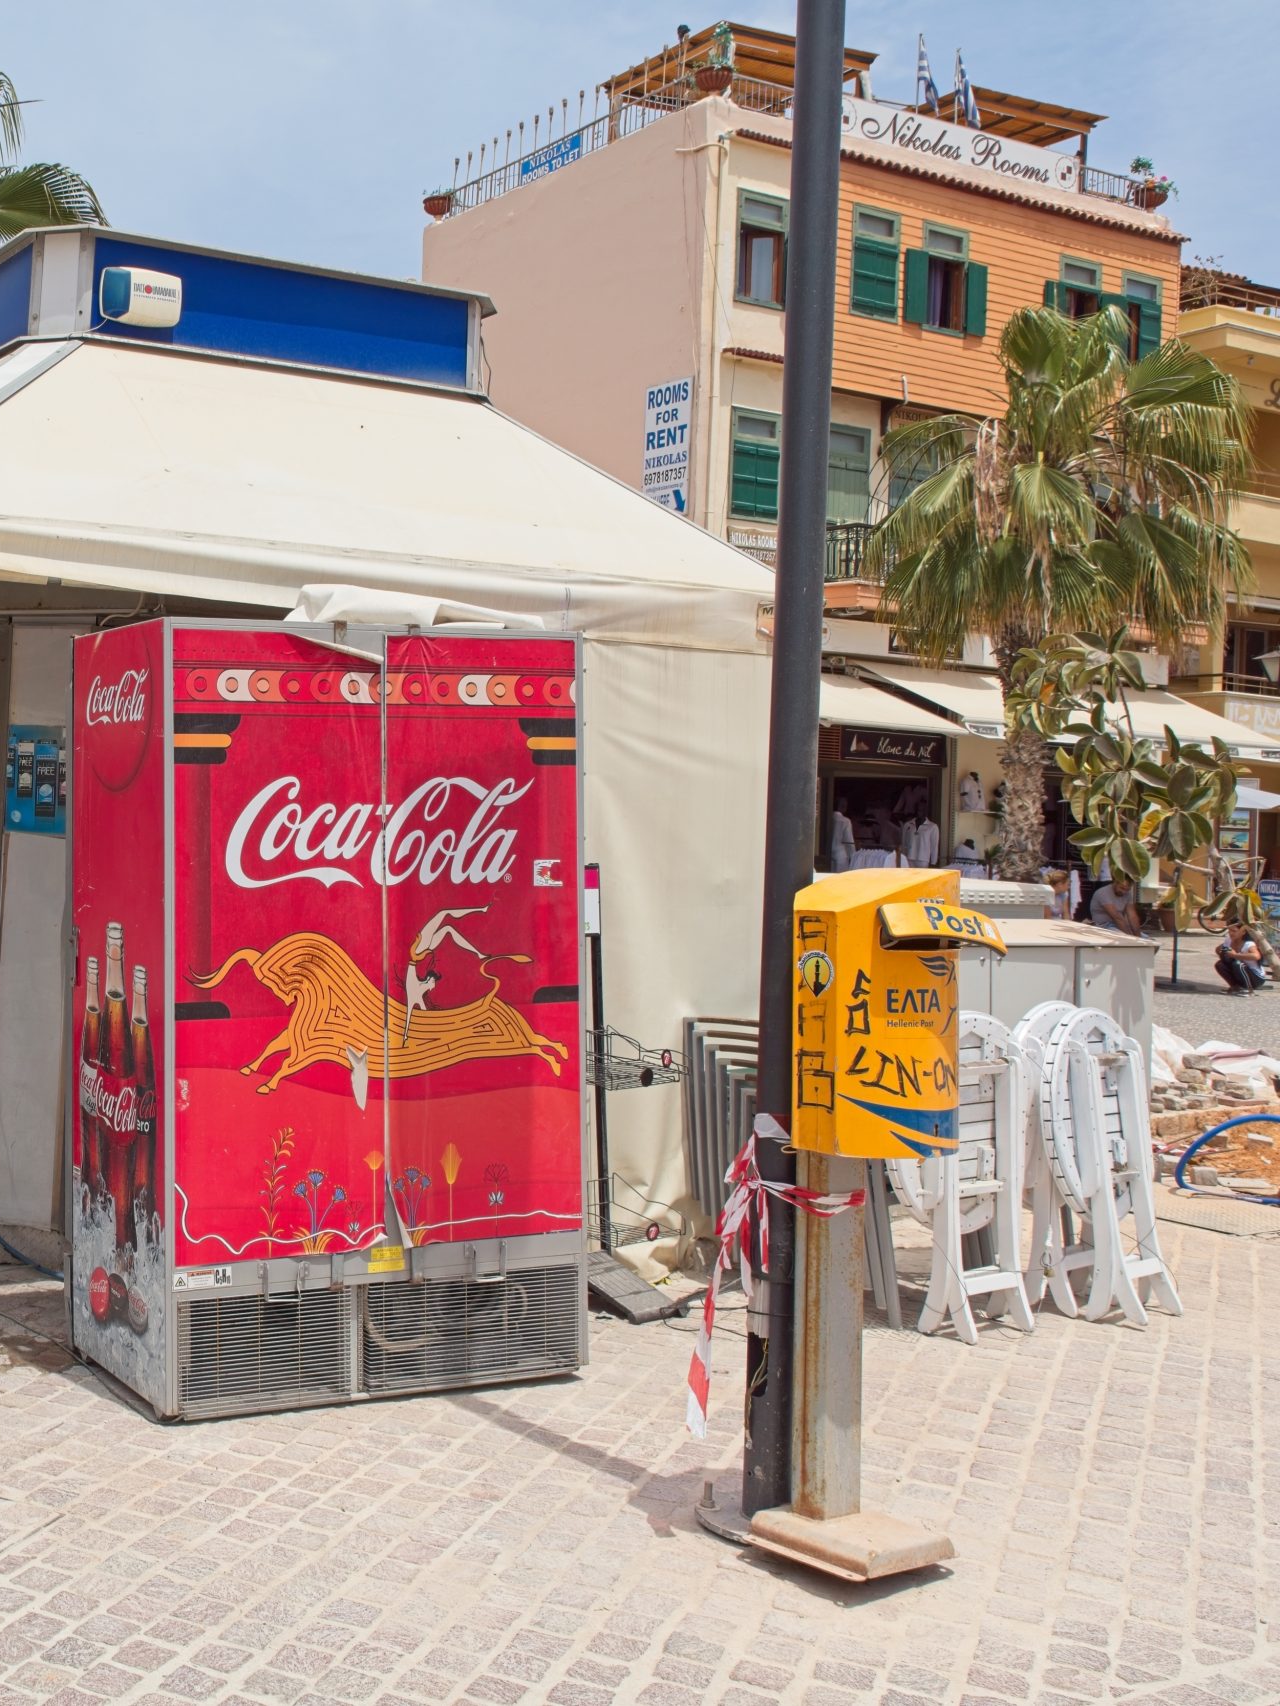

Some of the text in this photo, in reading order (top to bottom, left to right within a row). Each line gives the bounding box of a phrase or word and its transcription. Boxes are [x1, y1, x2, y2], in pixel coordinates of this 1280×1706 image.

[529, 140, 571, 170] NIKOLAS
[860, 112, 1050, 184] Nikolas Rooms
[522, 148, 580, 185] ROOMS TO LET
[647, 381, 689, 410] ROOMS
[655, 408, 679, 426] FOR
[646, 424, 688, 451] RENT
[644, 451, 688, 470] NIKOLAS
[644, 466, 687, 486] 6978187357
[86, 668, 149, 726] Coca-Cola
[904, 741, 917, 757] du
[225, 776, 536, 888] Coca-Cola
[923, 905, 985, 937] Post
[886, 988, 941, 1014] ΕΛΤΑ
[886, 1019, 934, 1028] Hellenic Post
[96, 1077, 138, 1132] Coca-Cola
